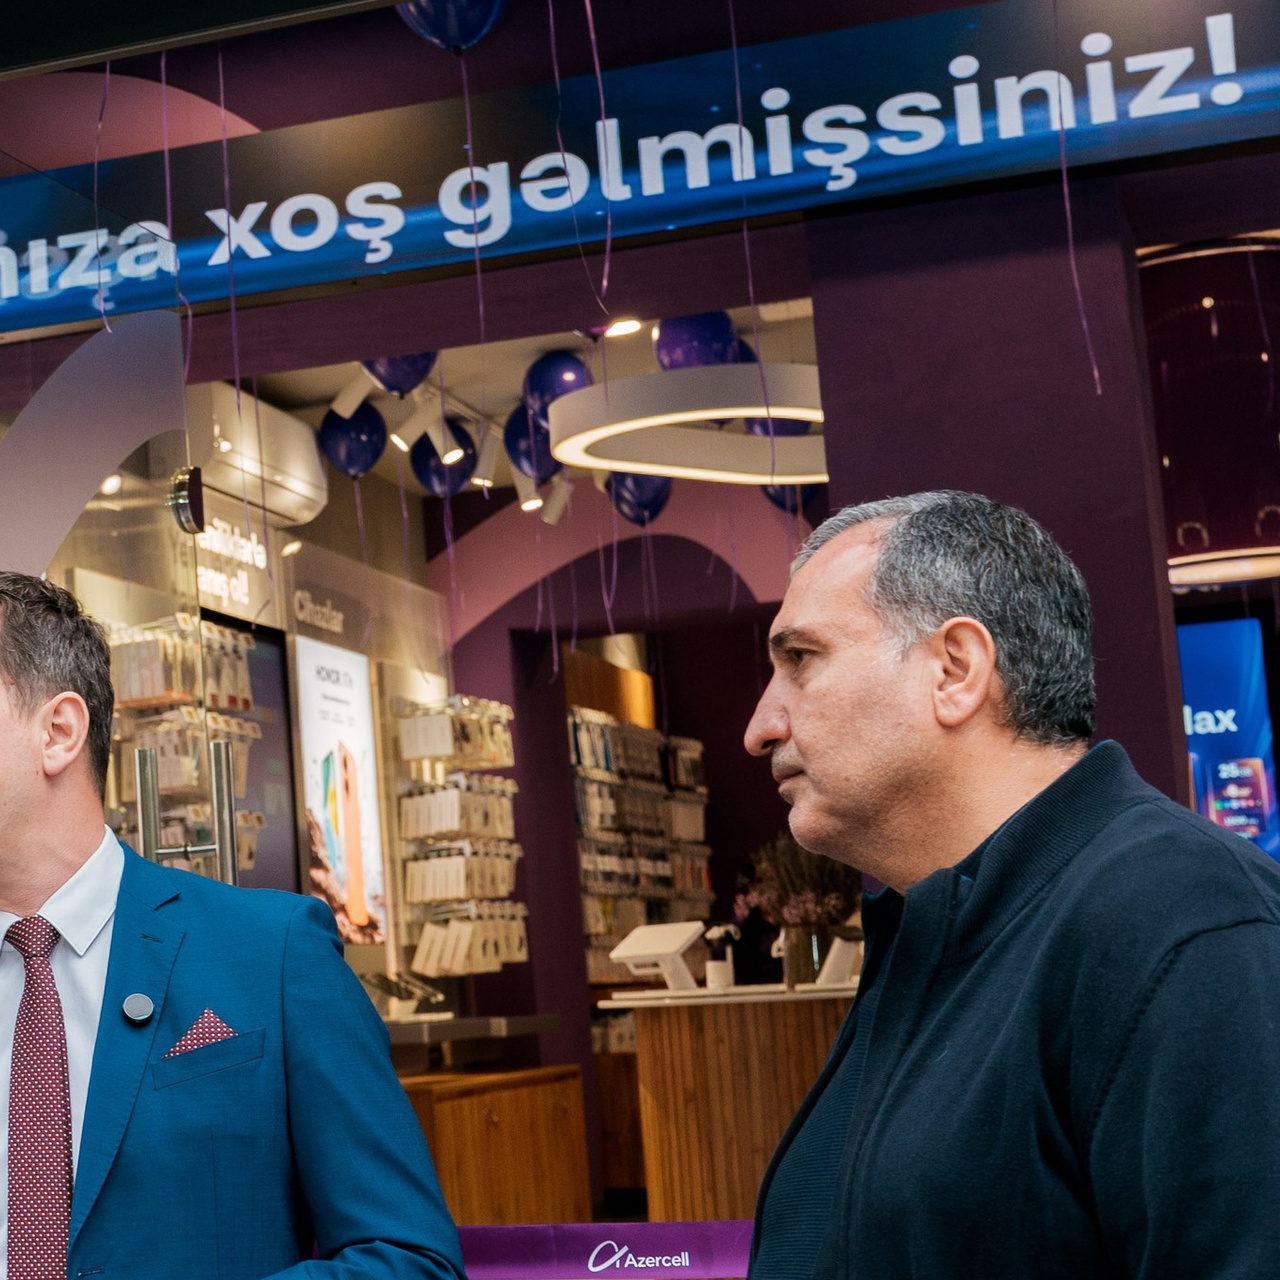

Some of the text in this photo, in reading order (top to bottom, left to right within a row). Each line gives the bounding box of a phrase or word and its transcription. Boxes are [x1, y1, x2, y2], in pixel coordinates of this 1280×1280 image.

[205, 181, 405, 265] xoş
[438, 13, 1245, 249] gəlmişsiniz!
[624, 1251, 689, 1268] Azercell
